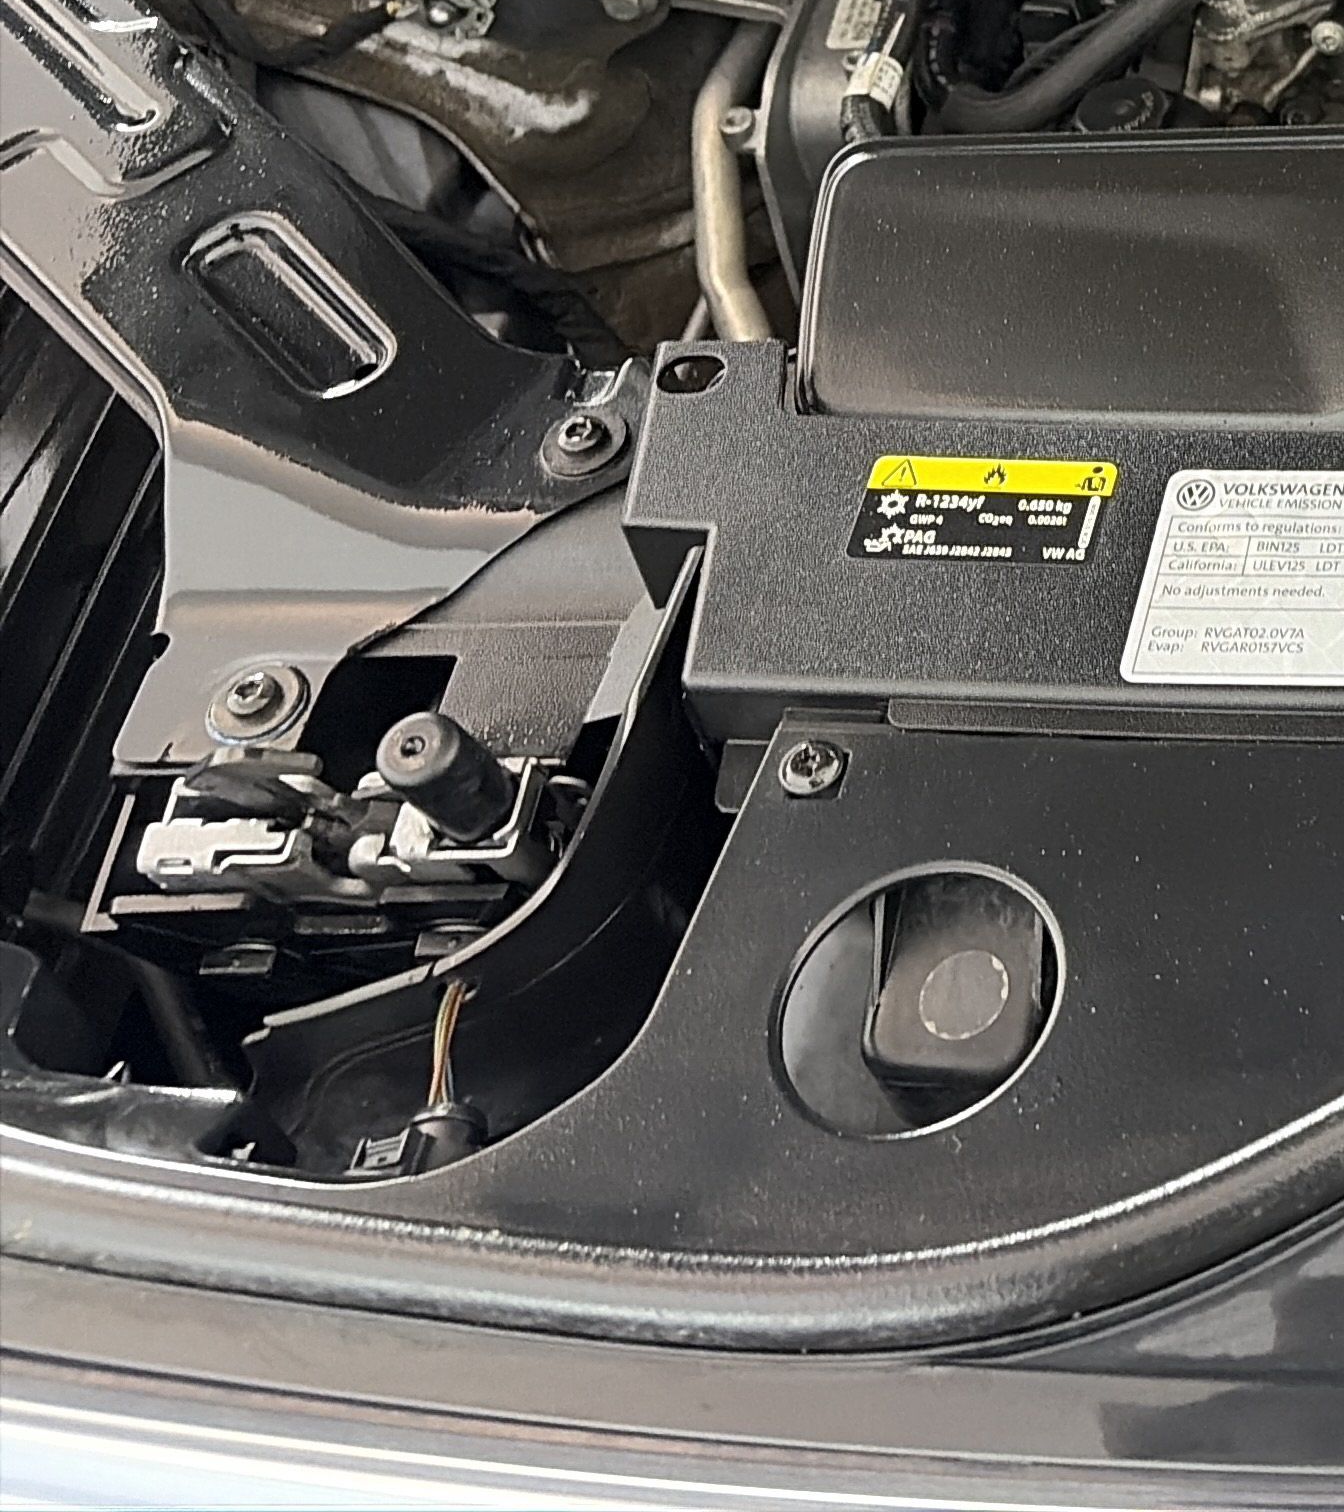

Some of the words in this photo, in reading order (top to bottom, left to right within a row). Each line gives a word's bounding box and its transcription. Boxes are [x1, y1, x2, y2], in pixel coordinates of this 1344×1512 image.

[915, 494, 985, 512] R-1234yf
[1055, 498, 1073, 515] kg
[1220, 498, 1272, 509] VEHICLE
[1277, 499, 1342, 510] EMISSION
[910, 514, 933, 525] GWP
[1178, 520, 1242, 533] Conforms
[1246, 521, 1259, 532] to
[1262, 522, 1341, 537] regulations:
[904, 530, 936, 544] PAG
[1043, 547, 1065, 560] VW
[1066, 548, 1086, 561] AG
[1173, 542, 1197, 553] U.S.
[1201, 542, 1229, 553] EPA:
[1256, 541, 1300, 553] BIN125
[1168, 559, 1237, 571] California:
[1253, 560, 1305, 571] ULEV125
[1315, 560, 1341, 572] LDT
[1162, 584, 1181, 597] No
[1184, 584, 1269, 599] adjustments
[1272, 585, 1325, 598] needed.
[1151, 626, 1198, 641] Group:
[1147, 640, 1184, 654] Evap:
